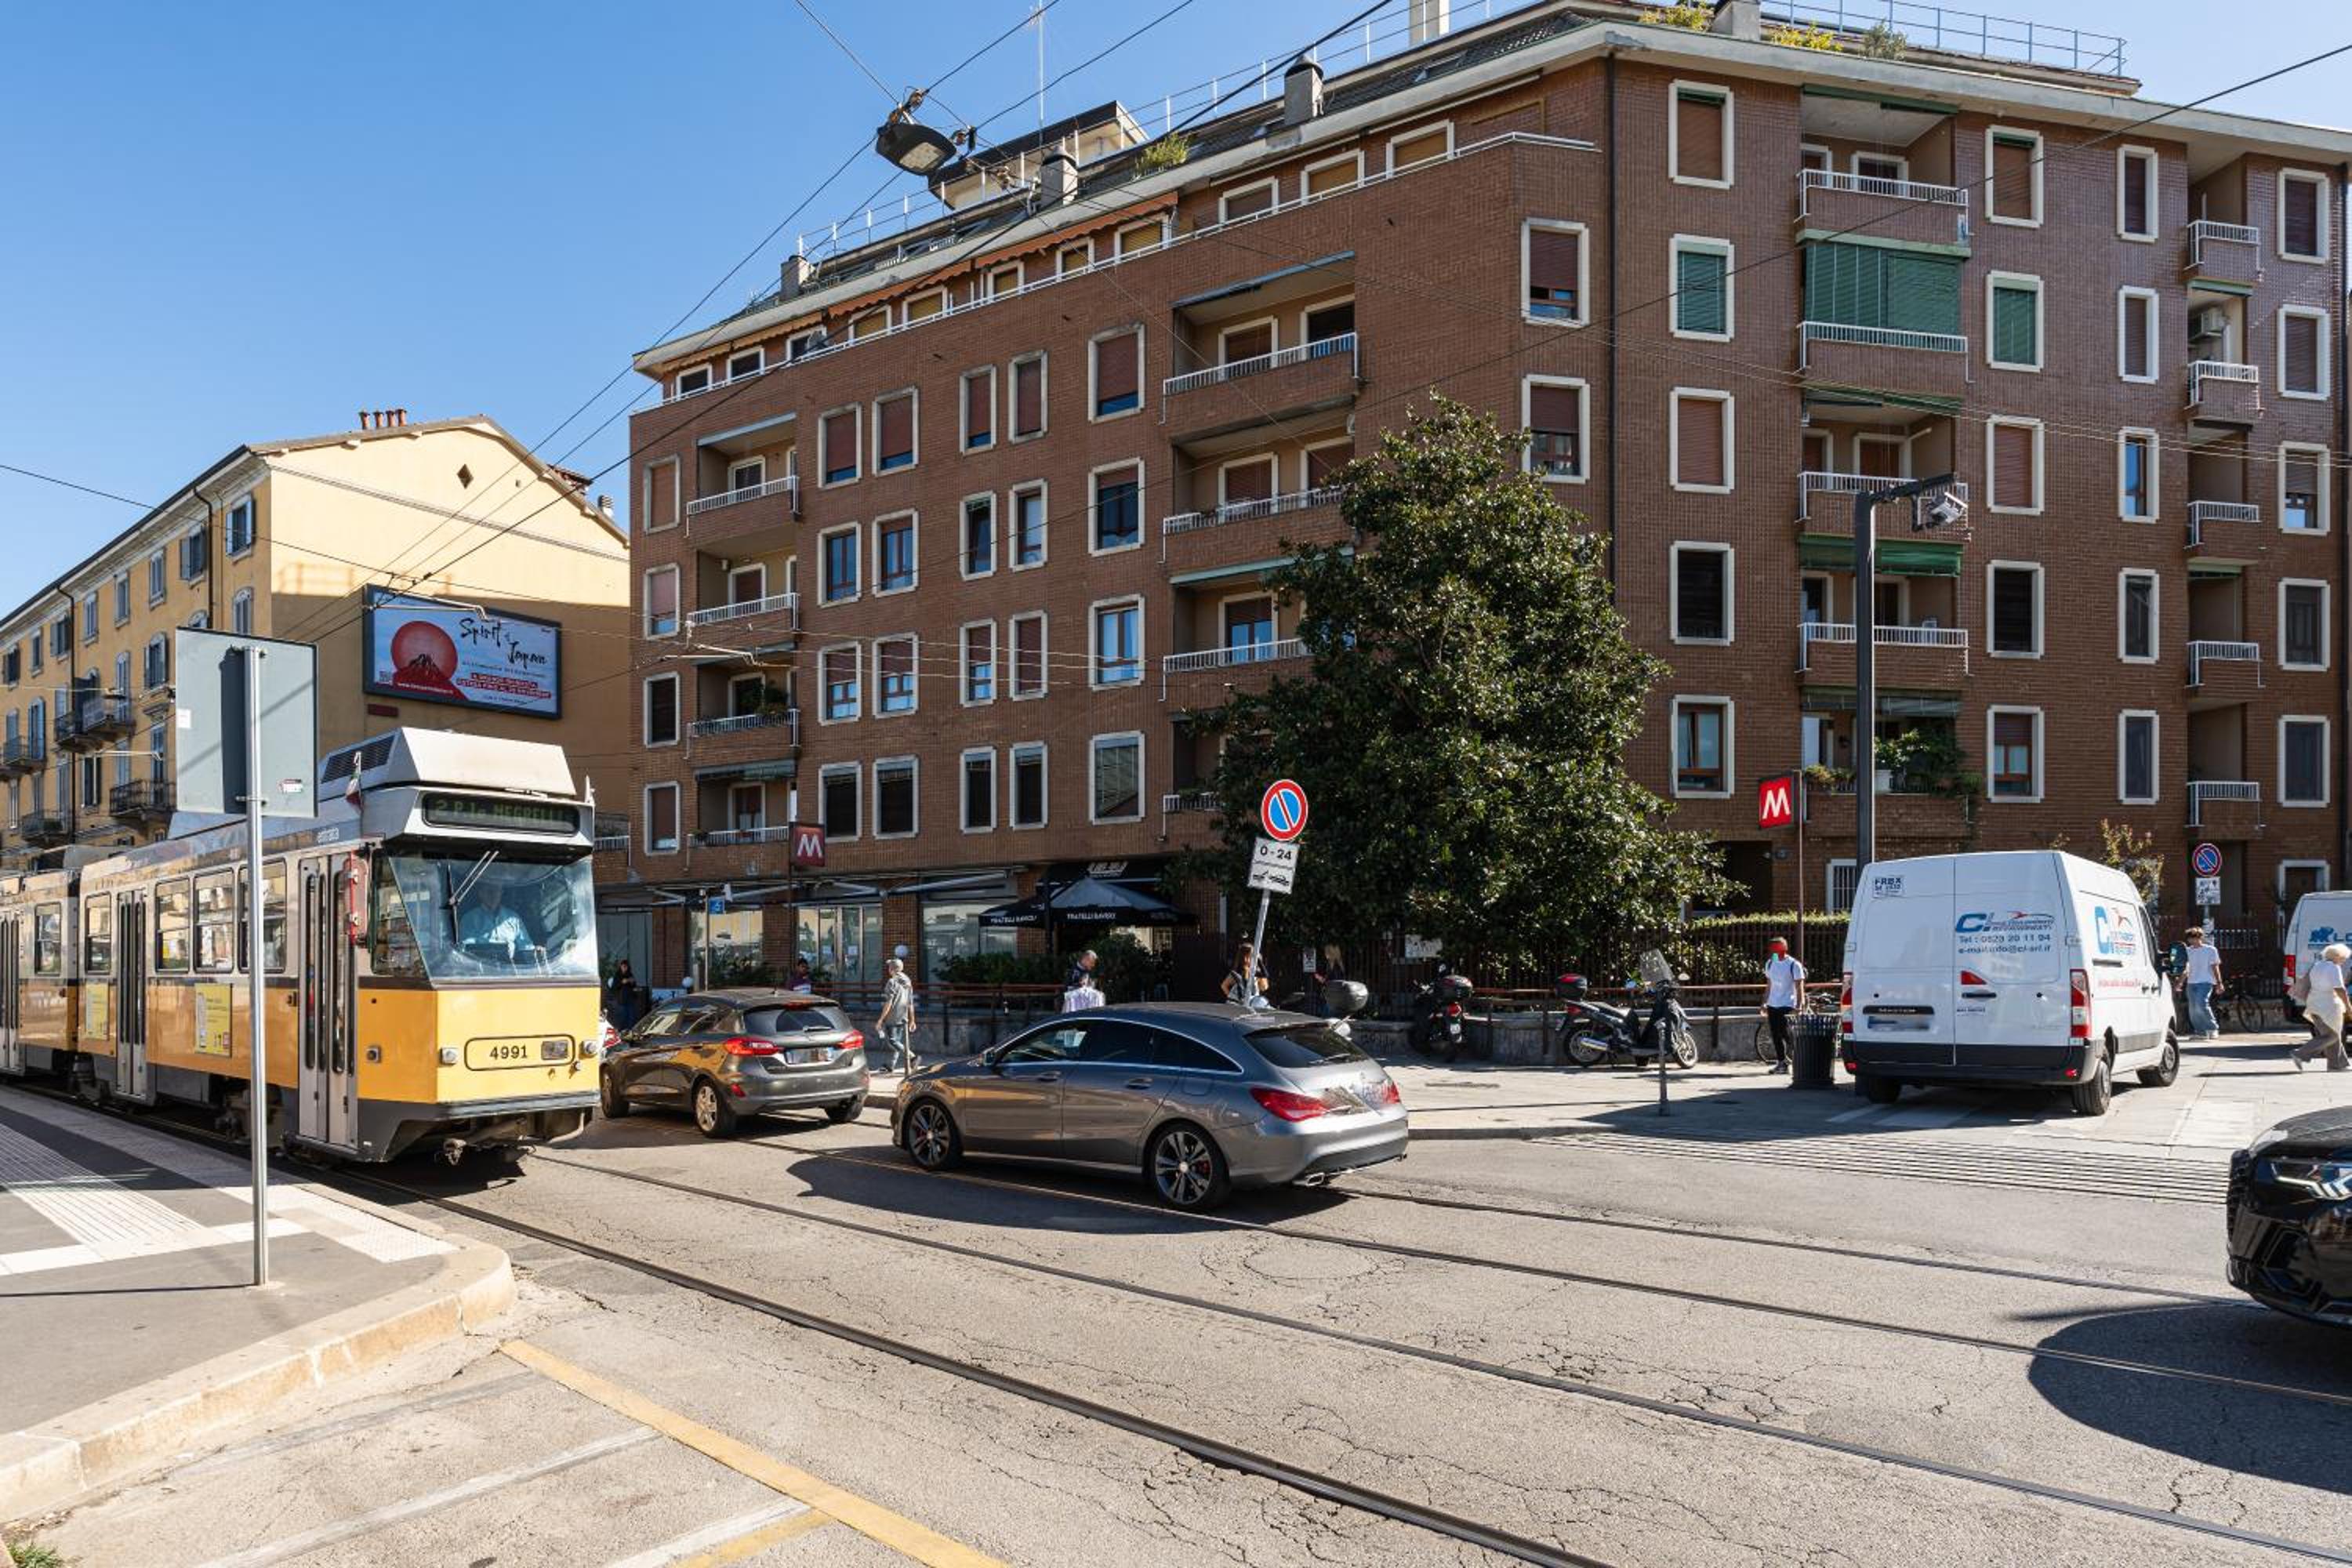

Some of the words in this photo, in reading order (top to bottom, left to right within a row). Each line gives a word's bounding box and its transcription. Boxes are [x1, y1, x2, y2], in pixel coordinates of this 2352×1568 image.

[459, 618, 501, 648] Spirit
[507, 641, 547, 670] Japan
[1762, 787, 1791, 820] M
[797, 833, 822, 858] M
[489, 1044, 528, 1060] 4991
